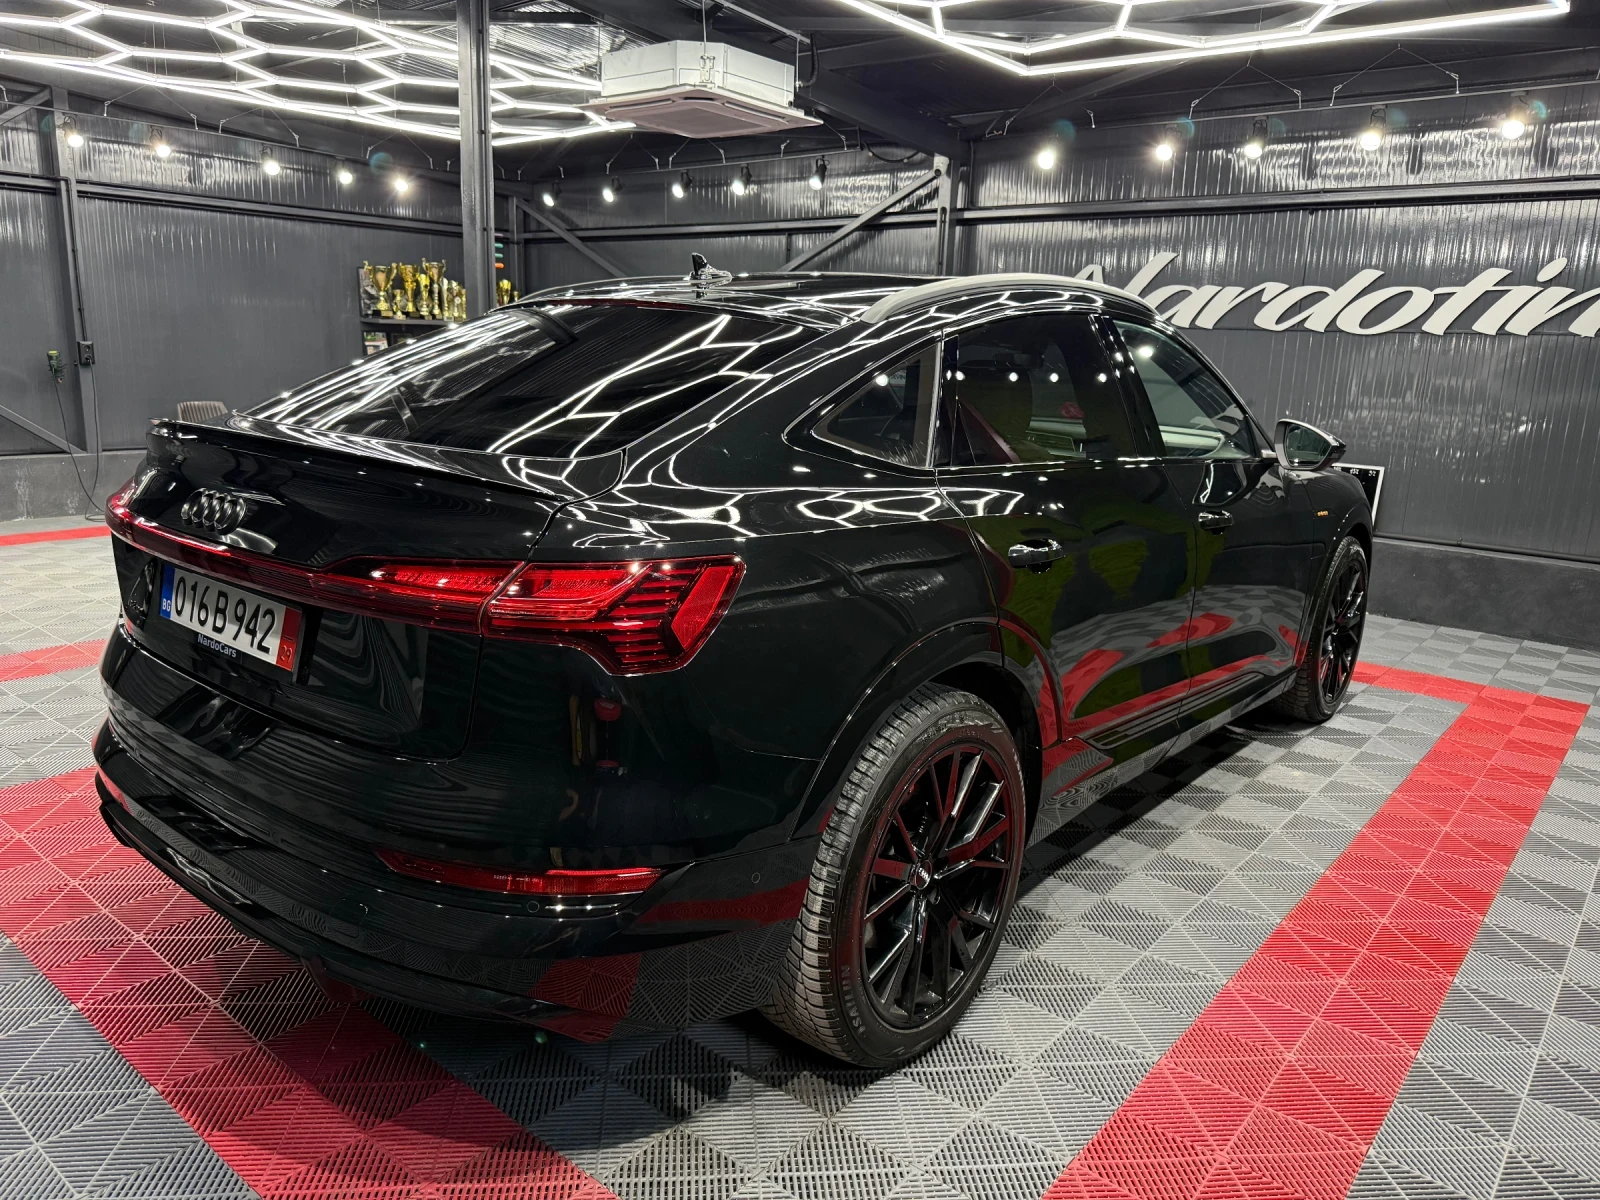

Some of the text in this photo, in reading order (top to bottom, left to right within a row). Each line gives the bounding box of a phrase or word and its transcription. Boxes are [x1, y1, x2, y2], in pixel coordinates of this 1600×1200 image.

[162, 598, 172, 612] BG
[279, 645, 293, 663] 29
[197, 633, 237, 658] NardoCars
